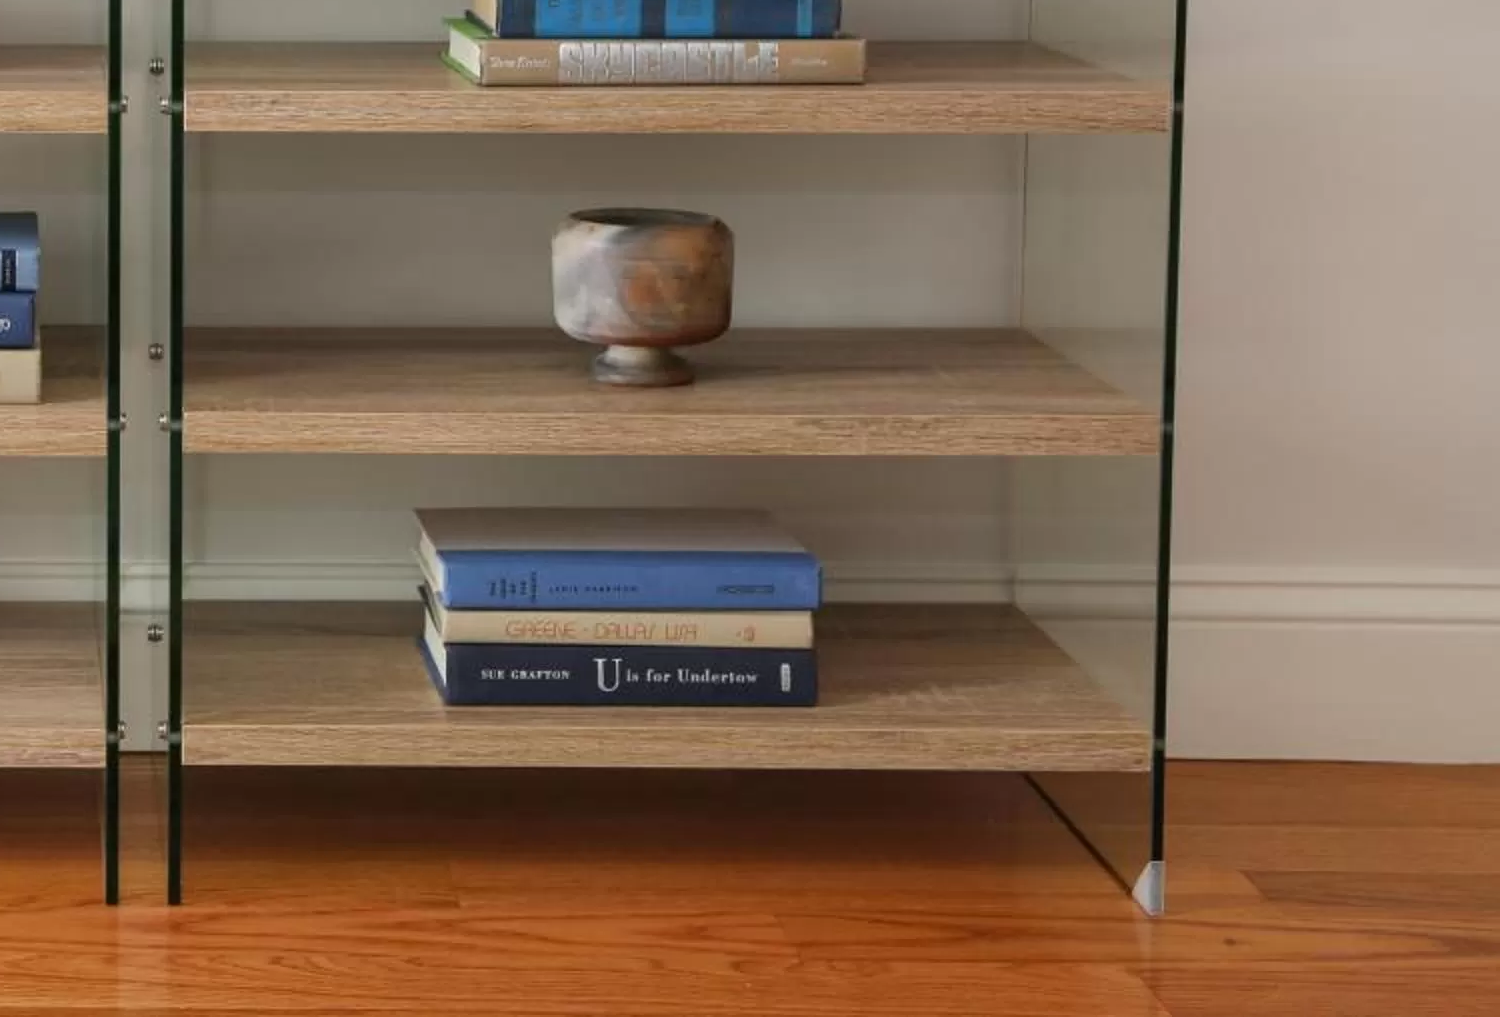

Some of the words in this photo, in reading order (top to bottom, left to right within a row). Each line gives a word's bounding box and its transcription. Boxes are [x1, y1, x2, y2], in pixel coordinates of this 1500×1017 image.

[506, 620, 577, 640] GREENE
[481, 669, 505, 680] SUE
[511, 669, 570, 680] GRAFTON
[593, 658, 623, 692] U
[626, 668, 639, 683] is
[646, 667, 671, 683] for
[677, 667, 758, 683] Undertow
